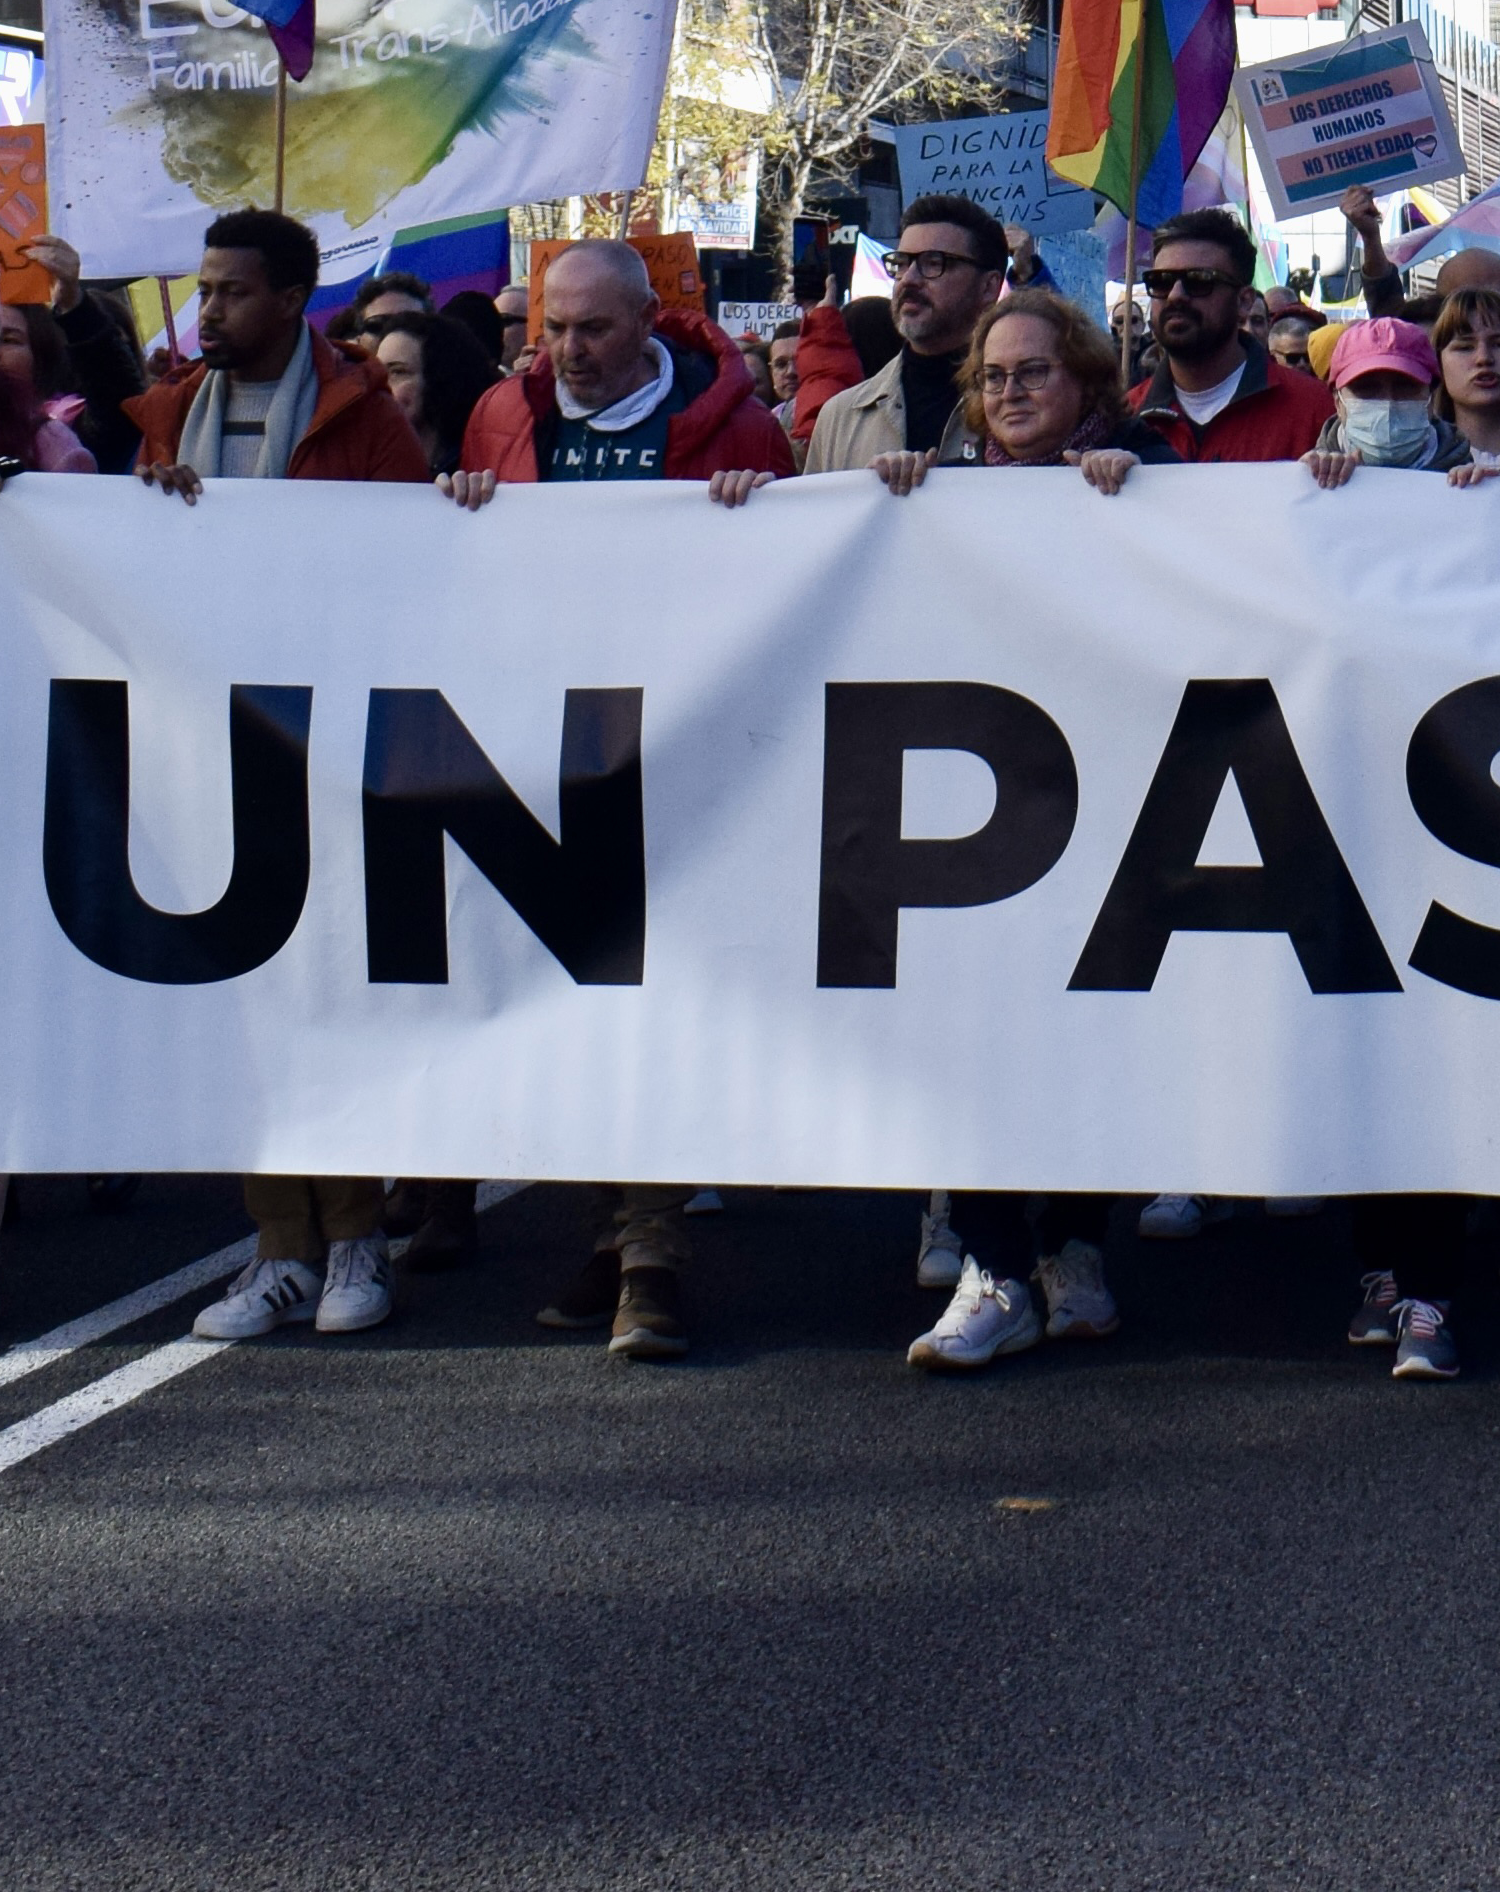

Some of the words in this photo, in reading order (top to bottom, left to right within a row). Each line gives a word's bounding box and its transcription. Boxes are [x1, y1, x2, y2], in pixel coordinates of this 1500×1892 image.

[1290, 104, 1317, 123] LOS
[1319, 79, 1394, 118] DERECHOS
[1312, 109, 1386, 143] HUMANOS
[932, 163, 995, 184] PARA
[1009, 160, 1033, 175] LA
[1302, 156, 1325, 178] NO
[1327, 142, 1374, 170] TIENEN
[1375, 131, 1416, 159] EDAD
[723, 303, 751, 320] LOS
[42, 676, 648, 986] UN
